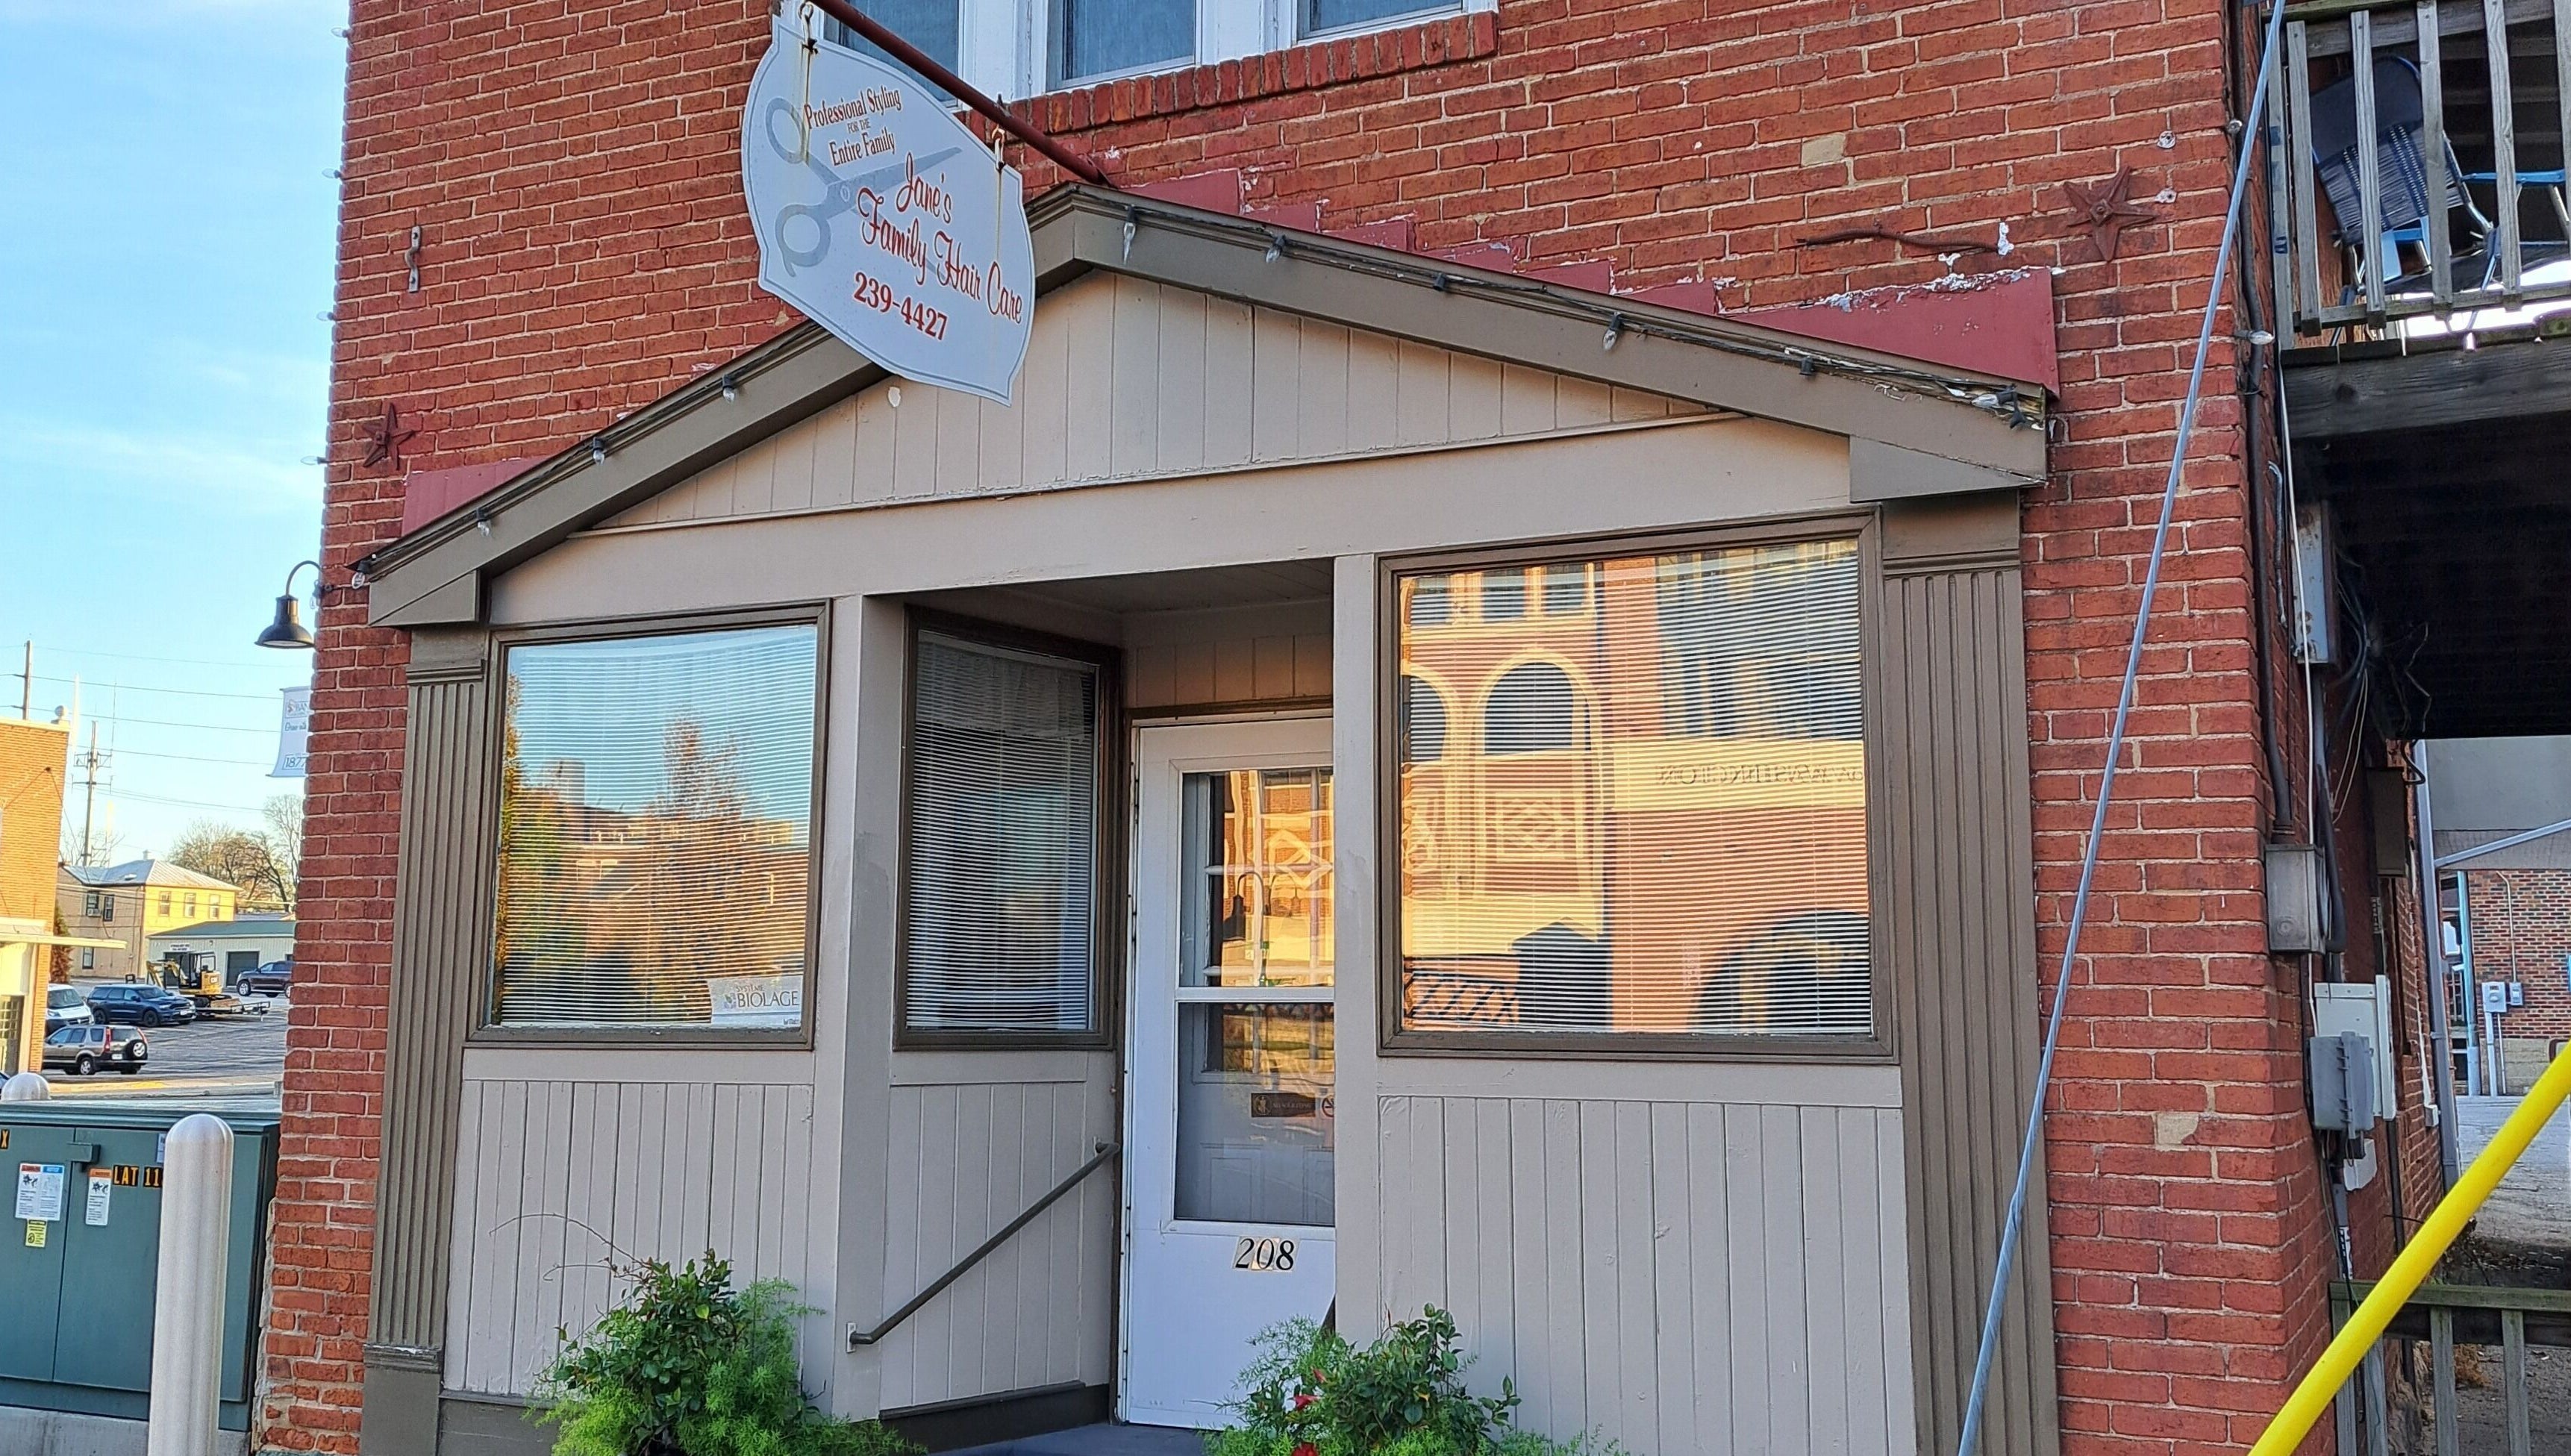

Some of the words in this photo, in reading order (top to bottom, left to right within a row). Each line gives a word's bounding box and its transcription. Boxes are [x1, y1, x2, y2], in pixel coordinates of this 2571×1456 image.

[804, 90, 867, 129] Professional
[866, 85, 902, 116] Styling
[847, 120, 859, 134] FOR
[859, 118, 871, 131] THE
[829, 140, 863, 166] Entire
[861, 125, 895, 154] Family
[896, 151, 952, 224] Jane's
[858, 187, 927, 286] Family
[934, 230, 981, 301] Hair
[987, 261, 1023, 324] Care
[853, 272, 948, 341] 239-4427
[737, 991, 800, 1007] BIOLAGE
[113, 1166, 138, 1186] LAT
[1235, 1238, 1294, 1271] 208
